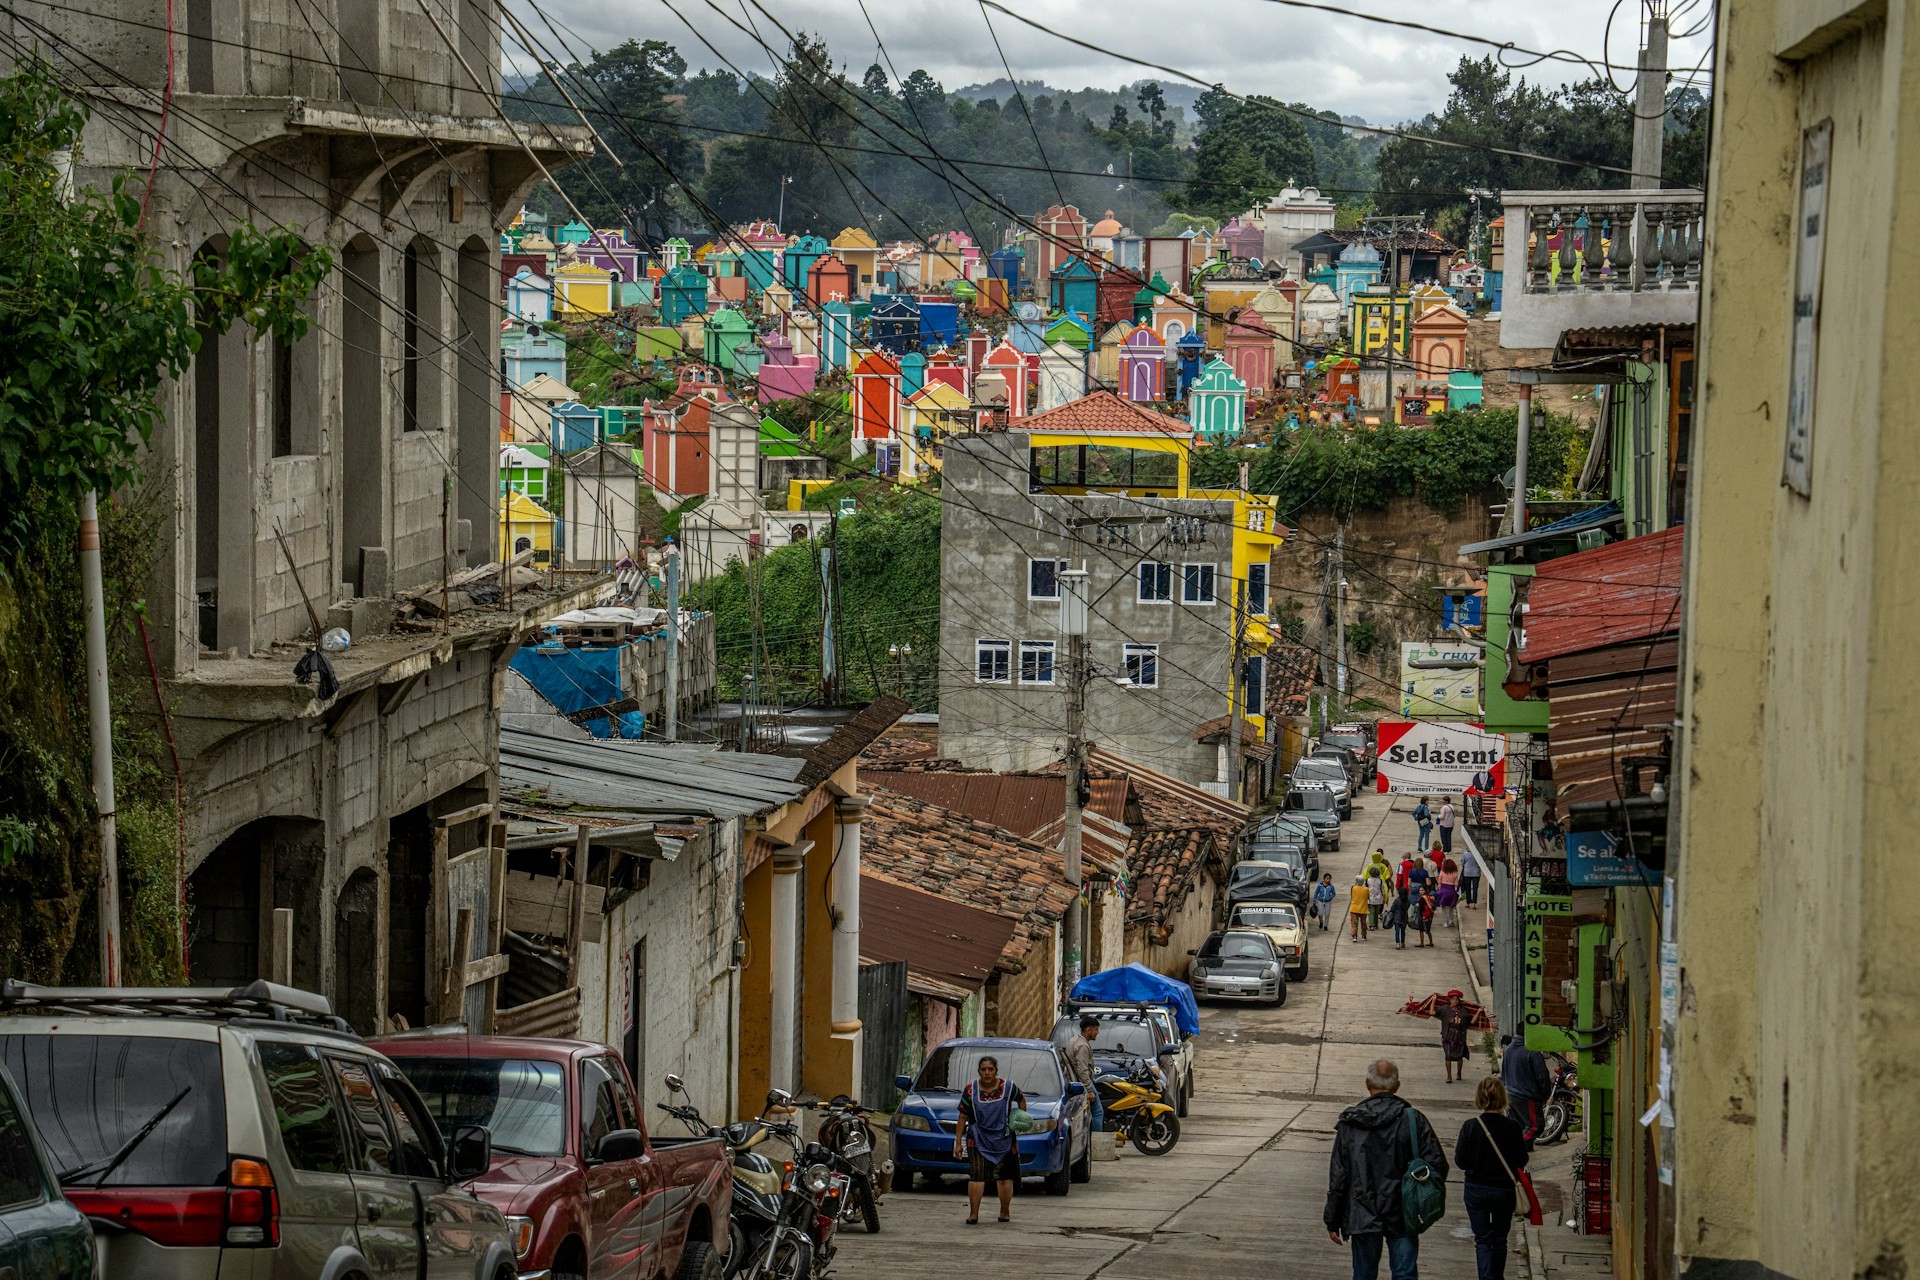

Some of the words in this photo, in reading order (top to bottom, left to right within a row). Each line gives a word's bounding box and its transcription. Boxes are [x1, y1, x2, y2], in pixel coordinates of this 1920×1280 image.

[1389, 743, 1498, 765] Selasent
[1577, 845, 1597, 859] Se
[1527, 900, 1573, 912] HOTE
[1525, 914, 1542, 1025] MASHITO
